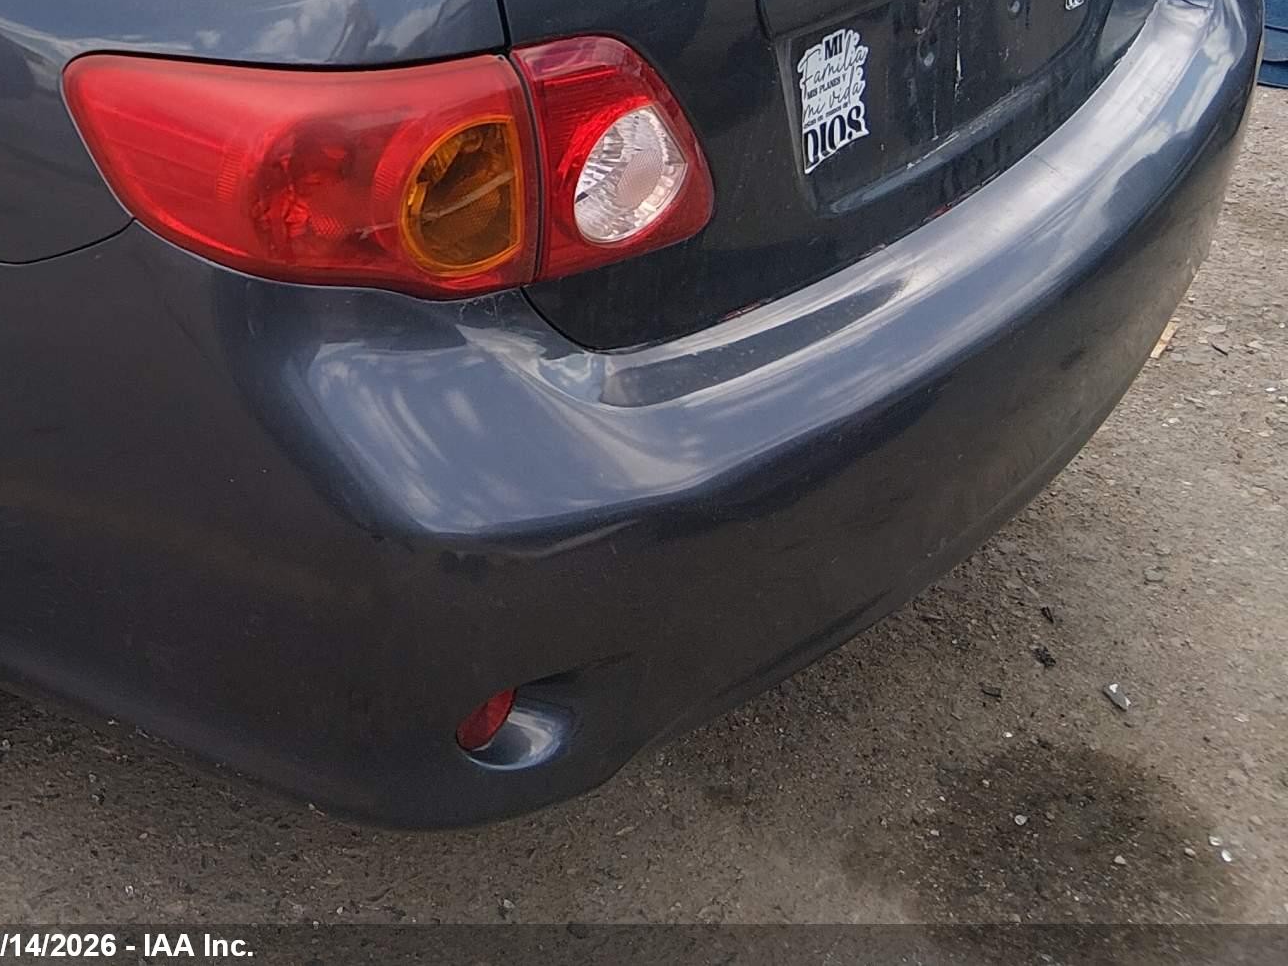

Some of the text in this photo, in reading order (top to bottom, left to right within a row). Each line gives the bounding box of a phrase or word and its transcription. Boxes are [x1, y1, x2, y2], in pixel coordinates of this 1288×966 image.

[799, 35, 864, 97] Familia
[824, 34, 843, 61] MI
[829, 65, 862, 104] vida
[804, 105, 863, 168] DIOS
